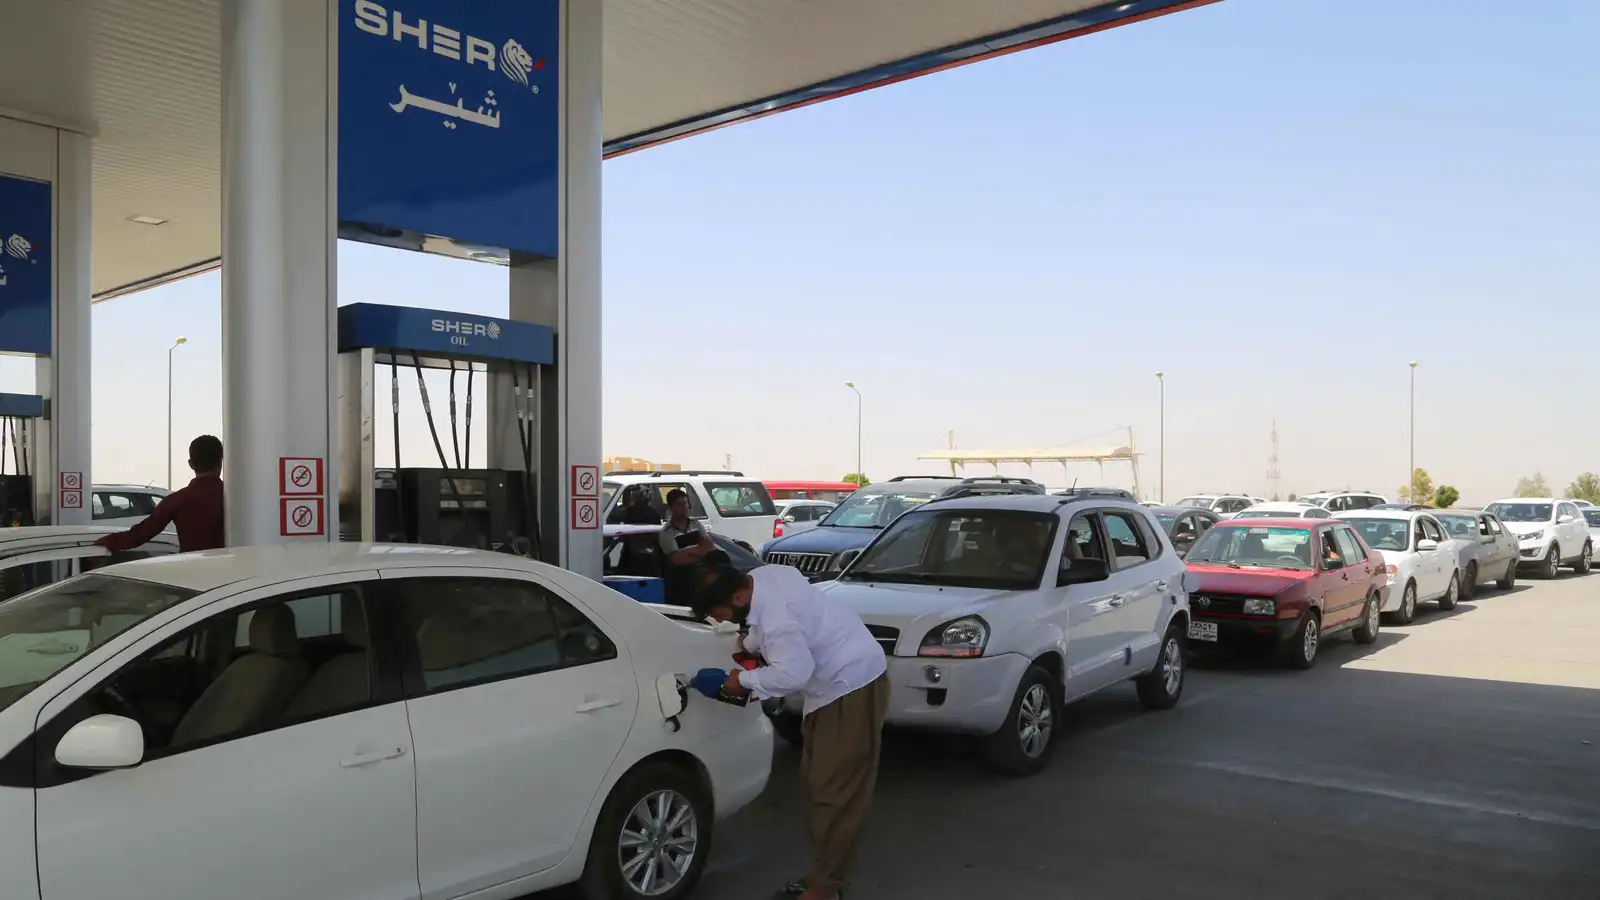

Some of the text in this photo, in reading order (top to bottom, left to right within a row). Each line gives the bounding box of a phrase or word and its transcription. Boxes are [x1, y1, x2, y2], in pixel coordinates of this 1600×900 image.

[354, 0, 496, 71] SHER
[431, 319, 486, 337] SHER
[450, 335, 470, 346] OIL
